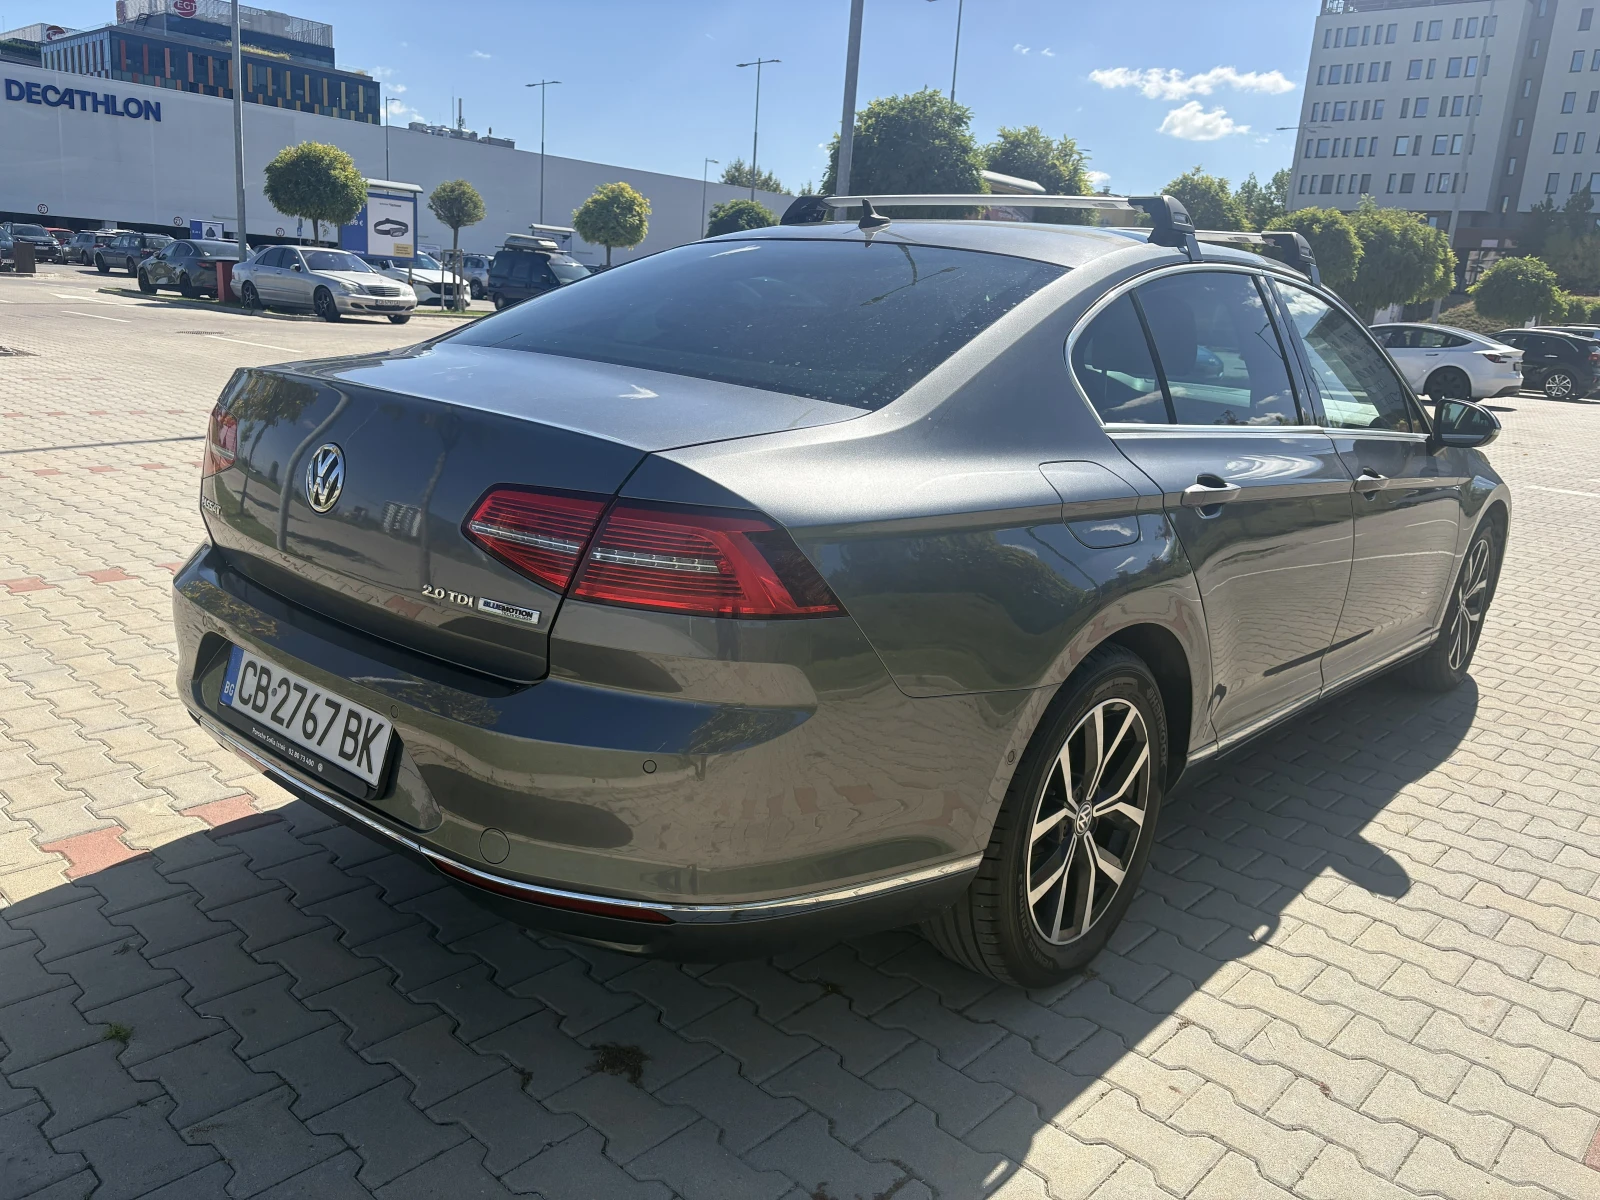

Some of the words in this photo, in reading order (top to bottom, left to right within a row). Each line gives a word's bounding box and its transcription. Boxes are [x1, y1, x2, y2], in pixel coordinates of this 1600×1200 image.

[177, 0, 197, 11] EGT
[4, 78, 162, 122] DECATHLON
[422, 584, 445, 600] 2.0
[447, 590, 475, 608] TDI
[482, 600, 534, 618] BLUEMOTION
[223, 681, 235, 696] BG
[252, 727, 266, 740] Porsche
[266, 735, 276, 746] Sofia
